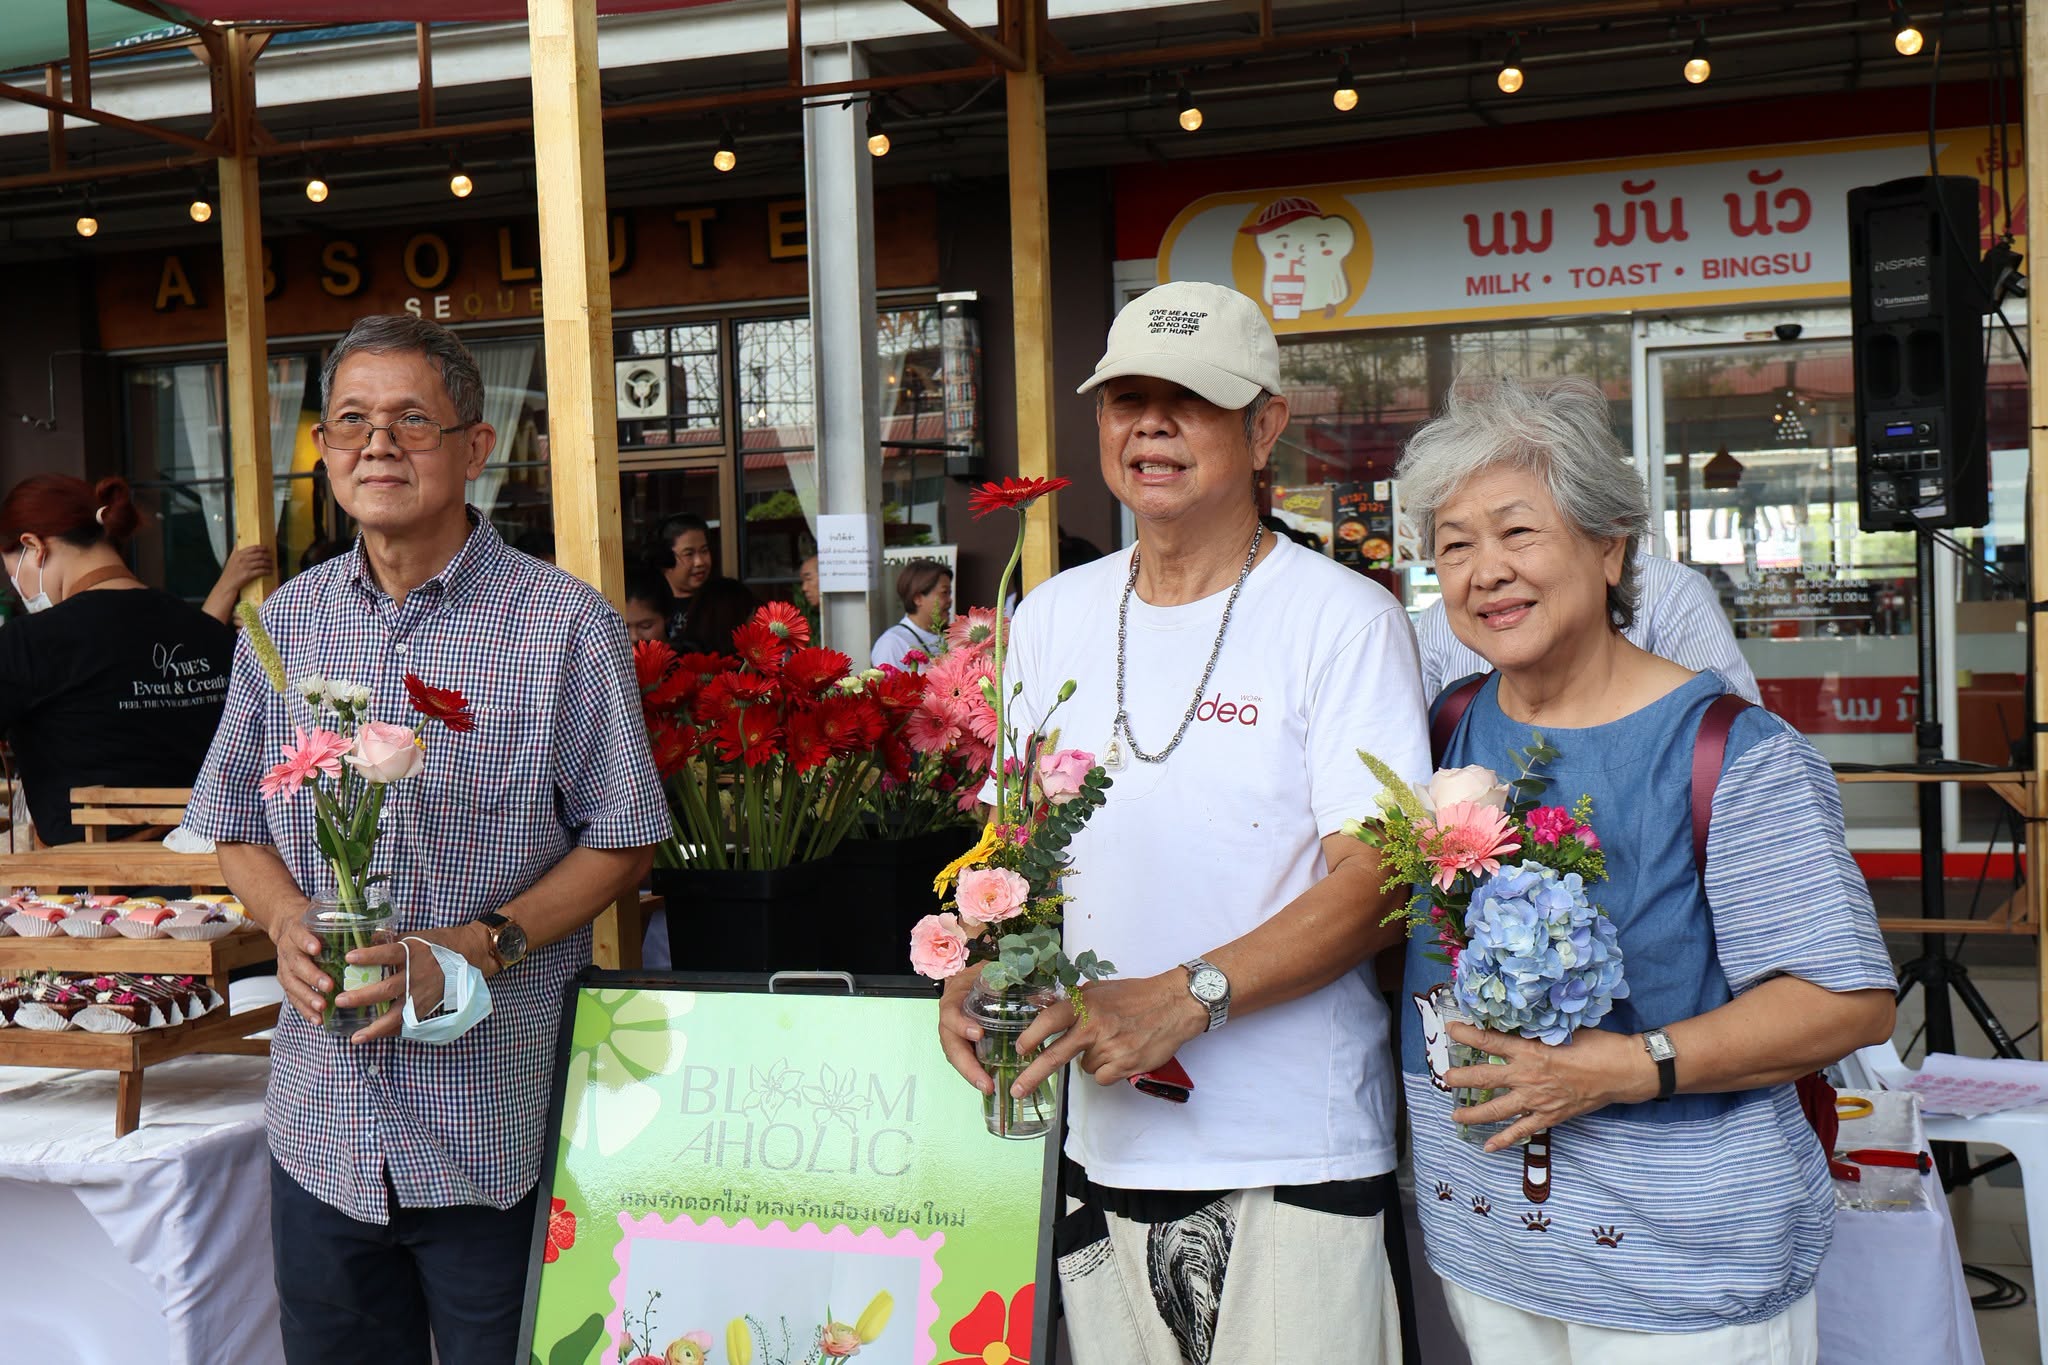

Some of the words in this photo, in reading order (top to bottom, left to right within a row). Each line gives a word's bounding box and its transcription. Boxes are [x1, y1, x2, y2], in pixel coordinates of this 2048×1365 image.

[1463, 208, 1553, 257] นม
[1593, 179, 1689, 248] มัน
[1723, 169, 1813, 237] นัว
[1466, 272, 1531, 296] MILK
[1568, 262, 1662, 289] TOAST
[1702, 252, 1812, 280] BINGSU
[404, 287, 543, 319] SEQUE
[1165, 316, 1200, 324] COFFEE
[1181, 323, 1200, 331] ONE
[1169, 328, 1194, 336] HURT
[133, 681, 172, 696] Event
[174, 681, 184, 695] &
[1240, 694, 1263, 702] WORK
[1197, 693, 1258, 726] dea
[672, 1120, 914, 1177] AHOLIC
